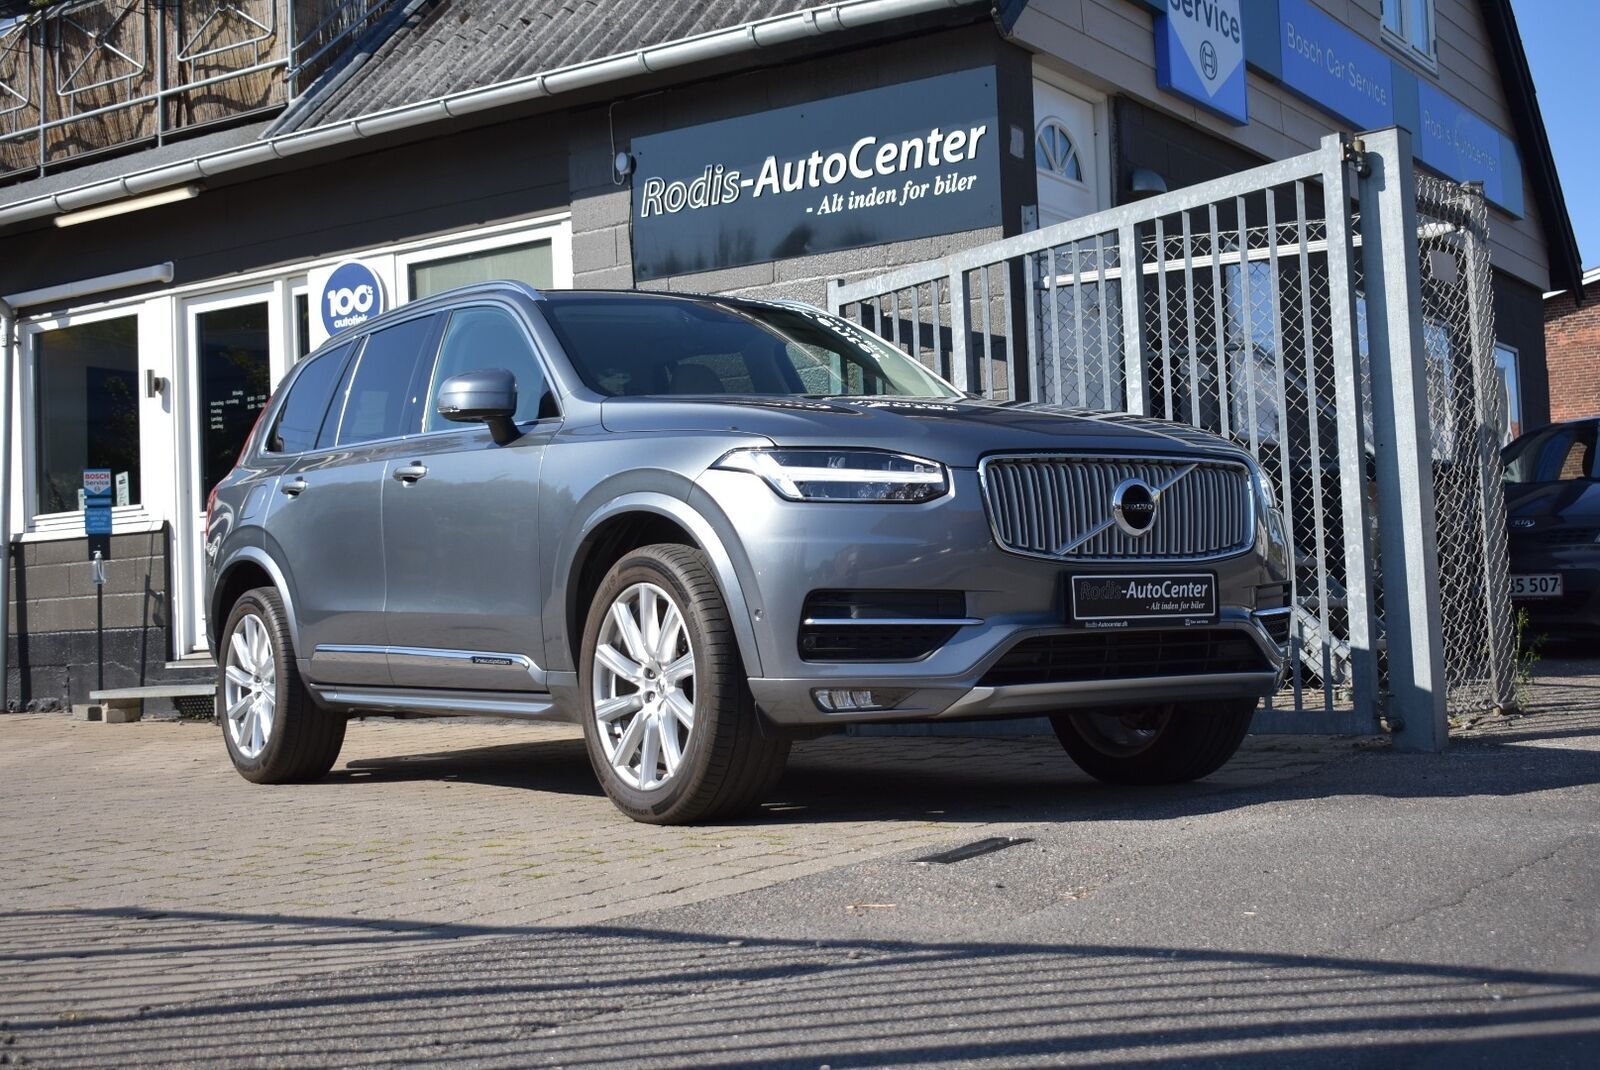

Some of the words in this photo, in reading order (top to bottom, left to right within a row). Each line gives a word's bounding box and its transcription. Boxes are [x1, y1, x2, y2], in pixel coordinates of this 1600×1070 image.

[1287, 22, 1323, 68] Bosch
[1326, 48, 1345, 80] Car
[1348, 62, 1387, 106] Service
[640, 124, 987, 218] Rodis-AutoCenter
[818, 192, 845, 216] Alt
[847, 187, 898, 211] inden
[899, 179, 930, 206] for
[933, 173, 977, 196] biler
[1080, 580, 1209, 600] Rodis-AutoCenter
[1529, 578, 1558, 593] 507
[1151, 602, 1160, 611] Alt
[1161, 601, 1179, 610] inden
[1179, 601, 1189, 612] for
[1190, 600, 1206, 609] biler
